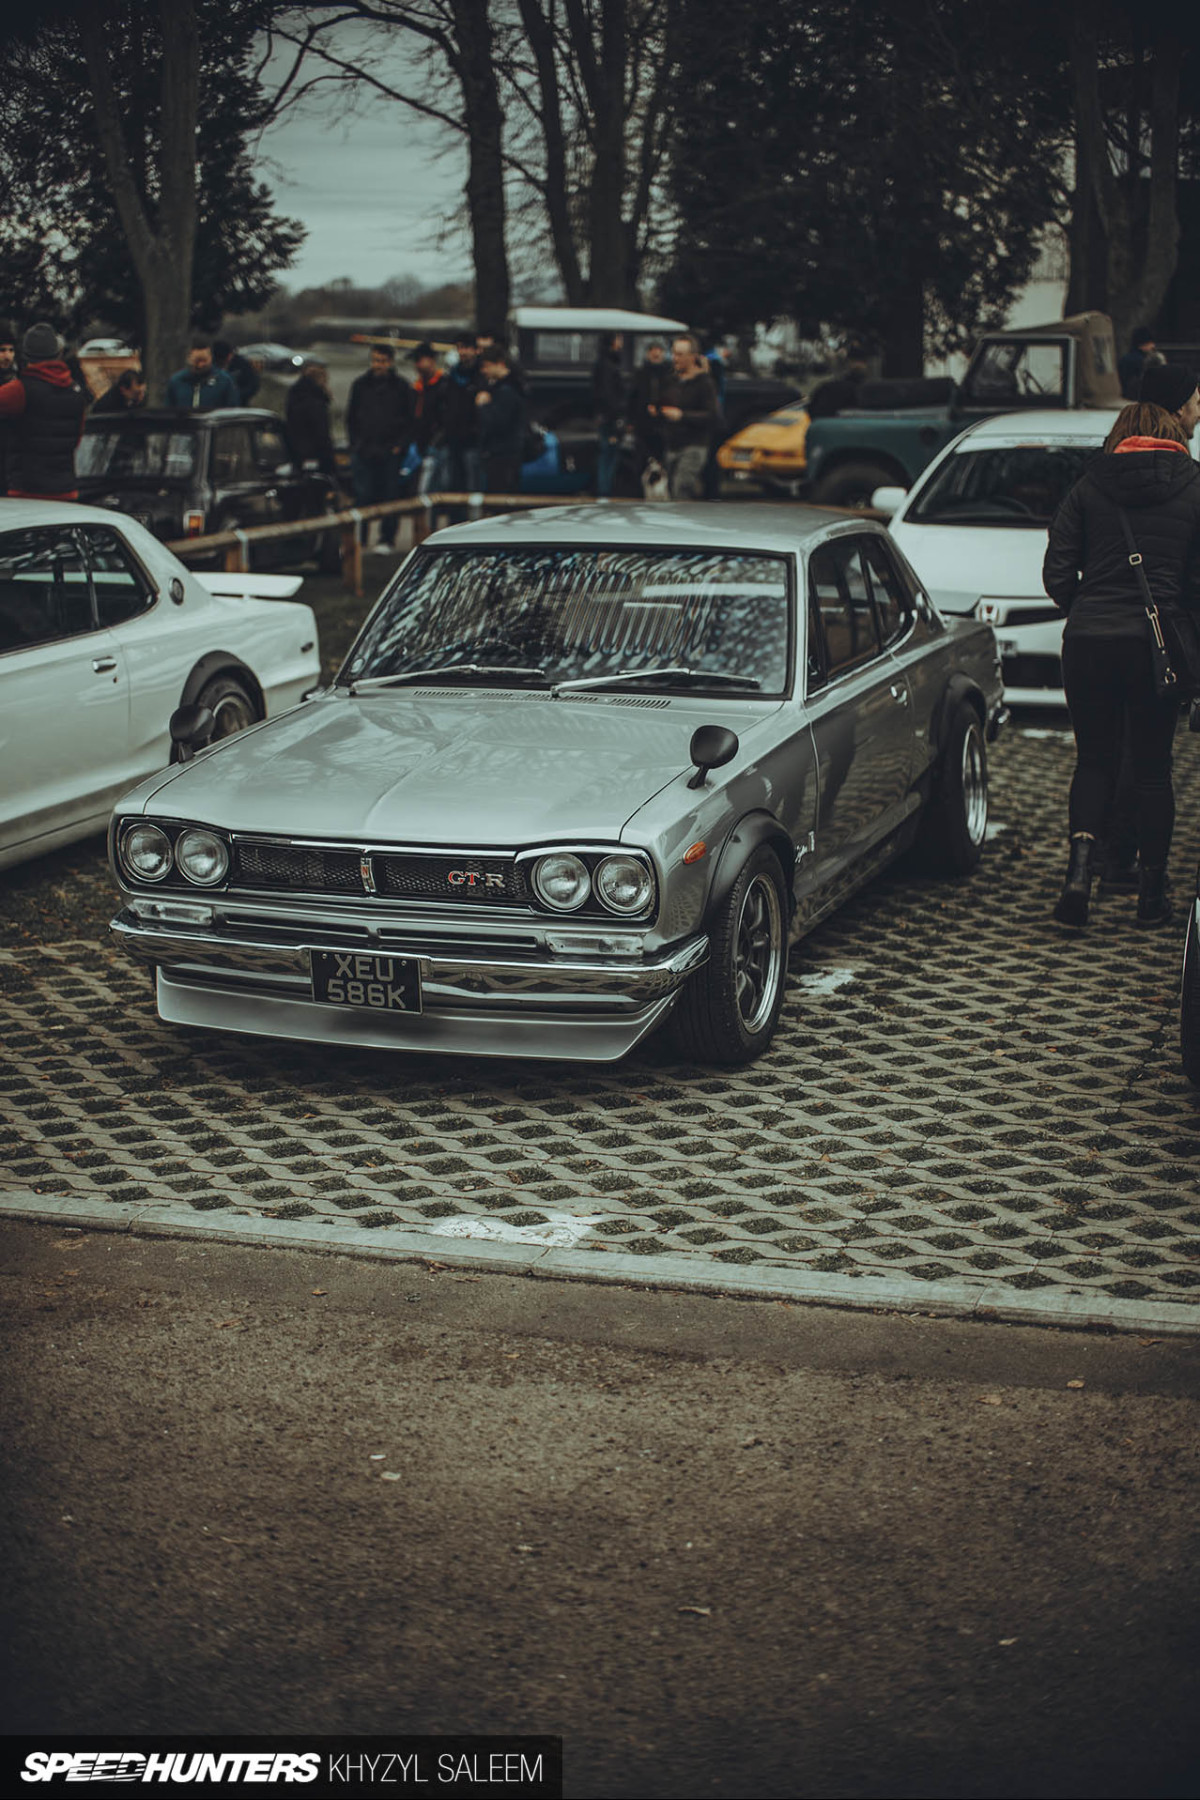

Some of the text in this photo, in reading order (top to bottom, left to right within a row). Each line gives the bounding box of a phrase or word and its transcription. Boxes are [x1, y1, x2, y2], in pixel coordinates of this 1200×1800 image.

[448, 870, 505, 888] GT-R
[334, 953, 394, 982] XEU
[327, 978, 406, 1009] 586K
